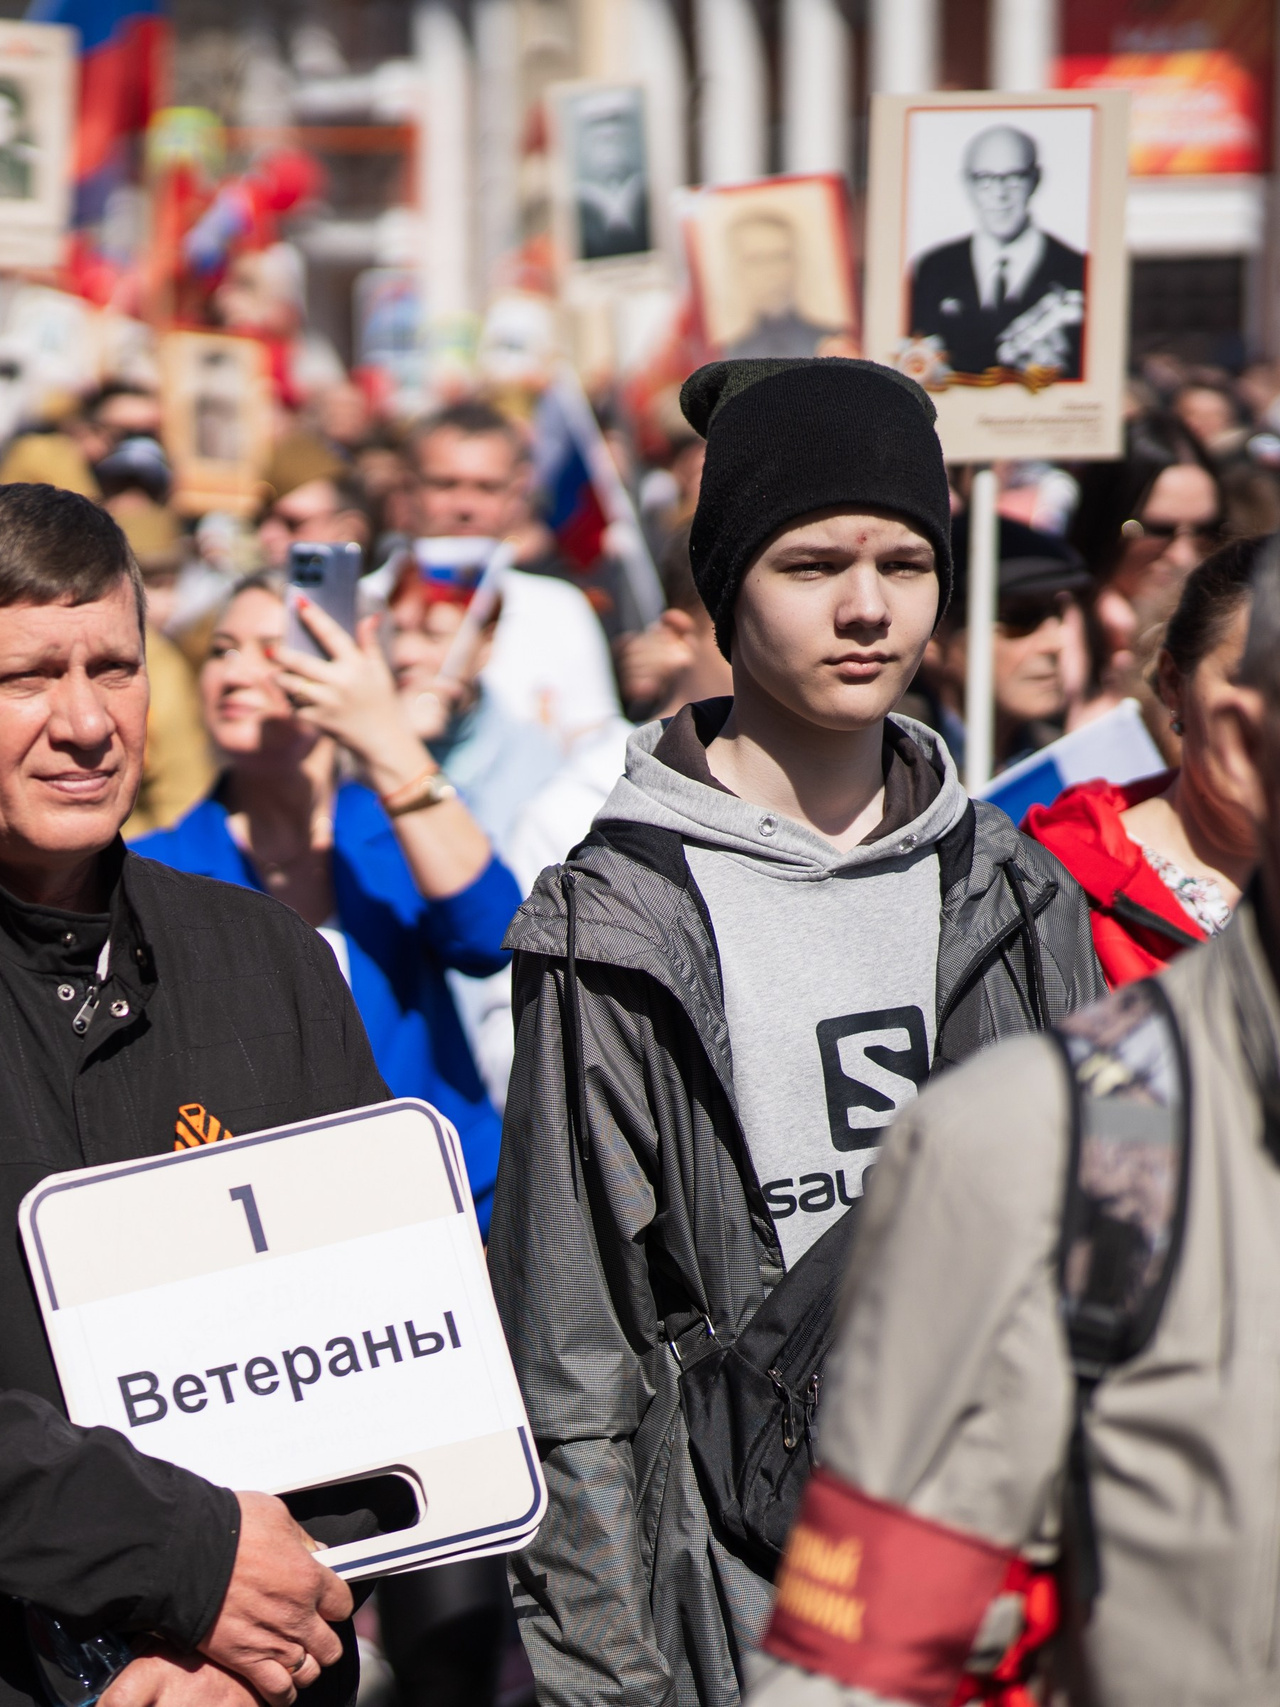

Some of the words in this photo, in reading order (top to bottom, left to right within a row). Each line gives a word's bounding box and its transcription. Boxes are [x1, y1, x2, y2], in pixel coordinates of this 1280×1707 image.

[228, 1183, 269, 1254] 1
[761, 1164, 878, 1219] sal
[116, 1310, 462, 1428] Ветераны
